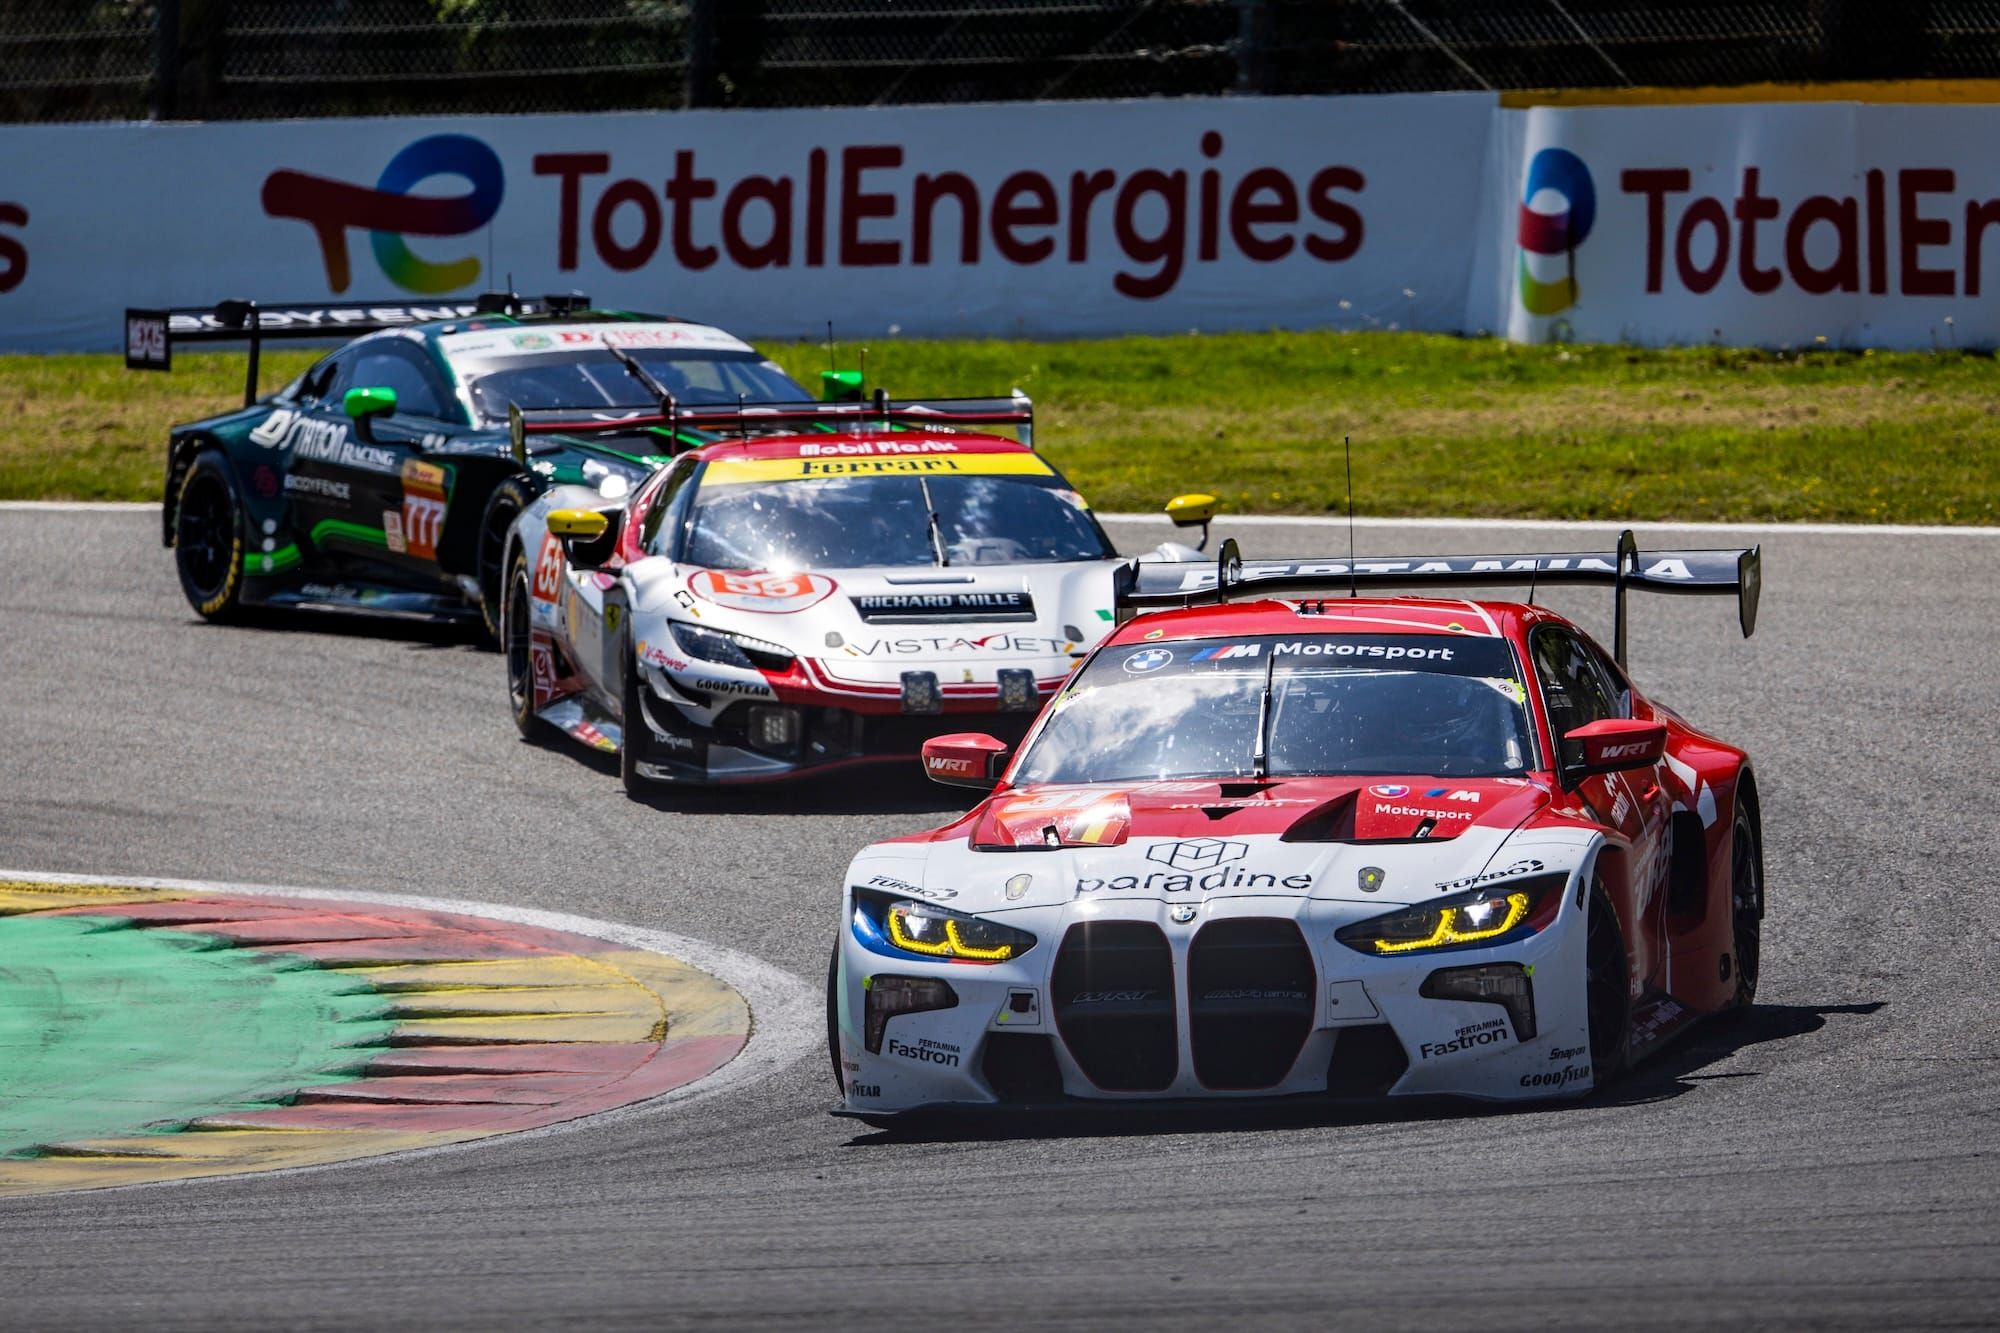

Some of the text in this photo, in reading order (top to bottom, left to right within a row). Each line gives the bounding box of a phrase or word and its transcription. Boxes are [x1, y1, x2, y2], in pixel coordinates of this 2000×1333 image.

[533, 130, 1365, 301] TotalEnergies
[340, 442, 397, 468] RACING
[800, 442, 874, 456] Mobil
[798, 457, 960, 475] Ferrari
[283, 473, 351, 499] BODYFENCE
[404, 493, 447, 550] 777
[538, 537, 564, 595] 55
[724, 577, 800, 598] 55
[860, 593, 1020, 609] RICHARD MILLE
[1272, 642, 1455, 661] Motorsport
[696, 679, 770, 697] GOODYEAR
[1600, 741, 1652, 759] WRT
[929, 756, 972, 772] WRT
[1375, 803, 1472, 820] Motorsport
[1074, 866, 1312, 899] paradine
[1436, 867, 1529, 892] TURBO
[1454, 1018, 1505, 1037] PERTAMINA
[888, 1039, 959, 1067] Fastron
[918, 1038, 961, 1053] PERTAMINA
[1420, 1028, 1508, 1059] Fastron
[1519, 1065, 1590, 1089] GOODYEAR
